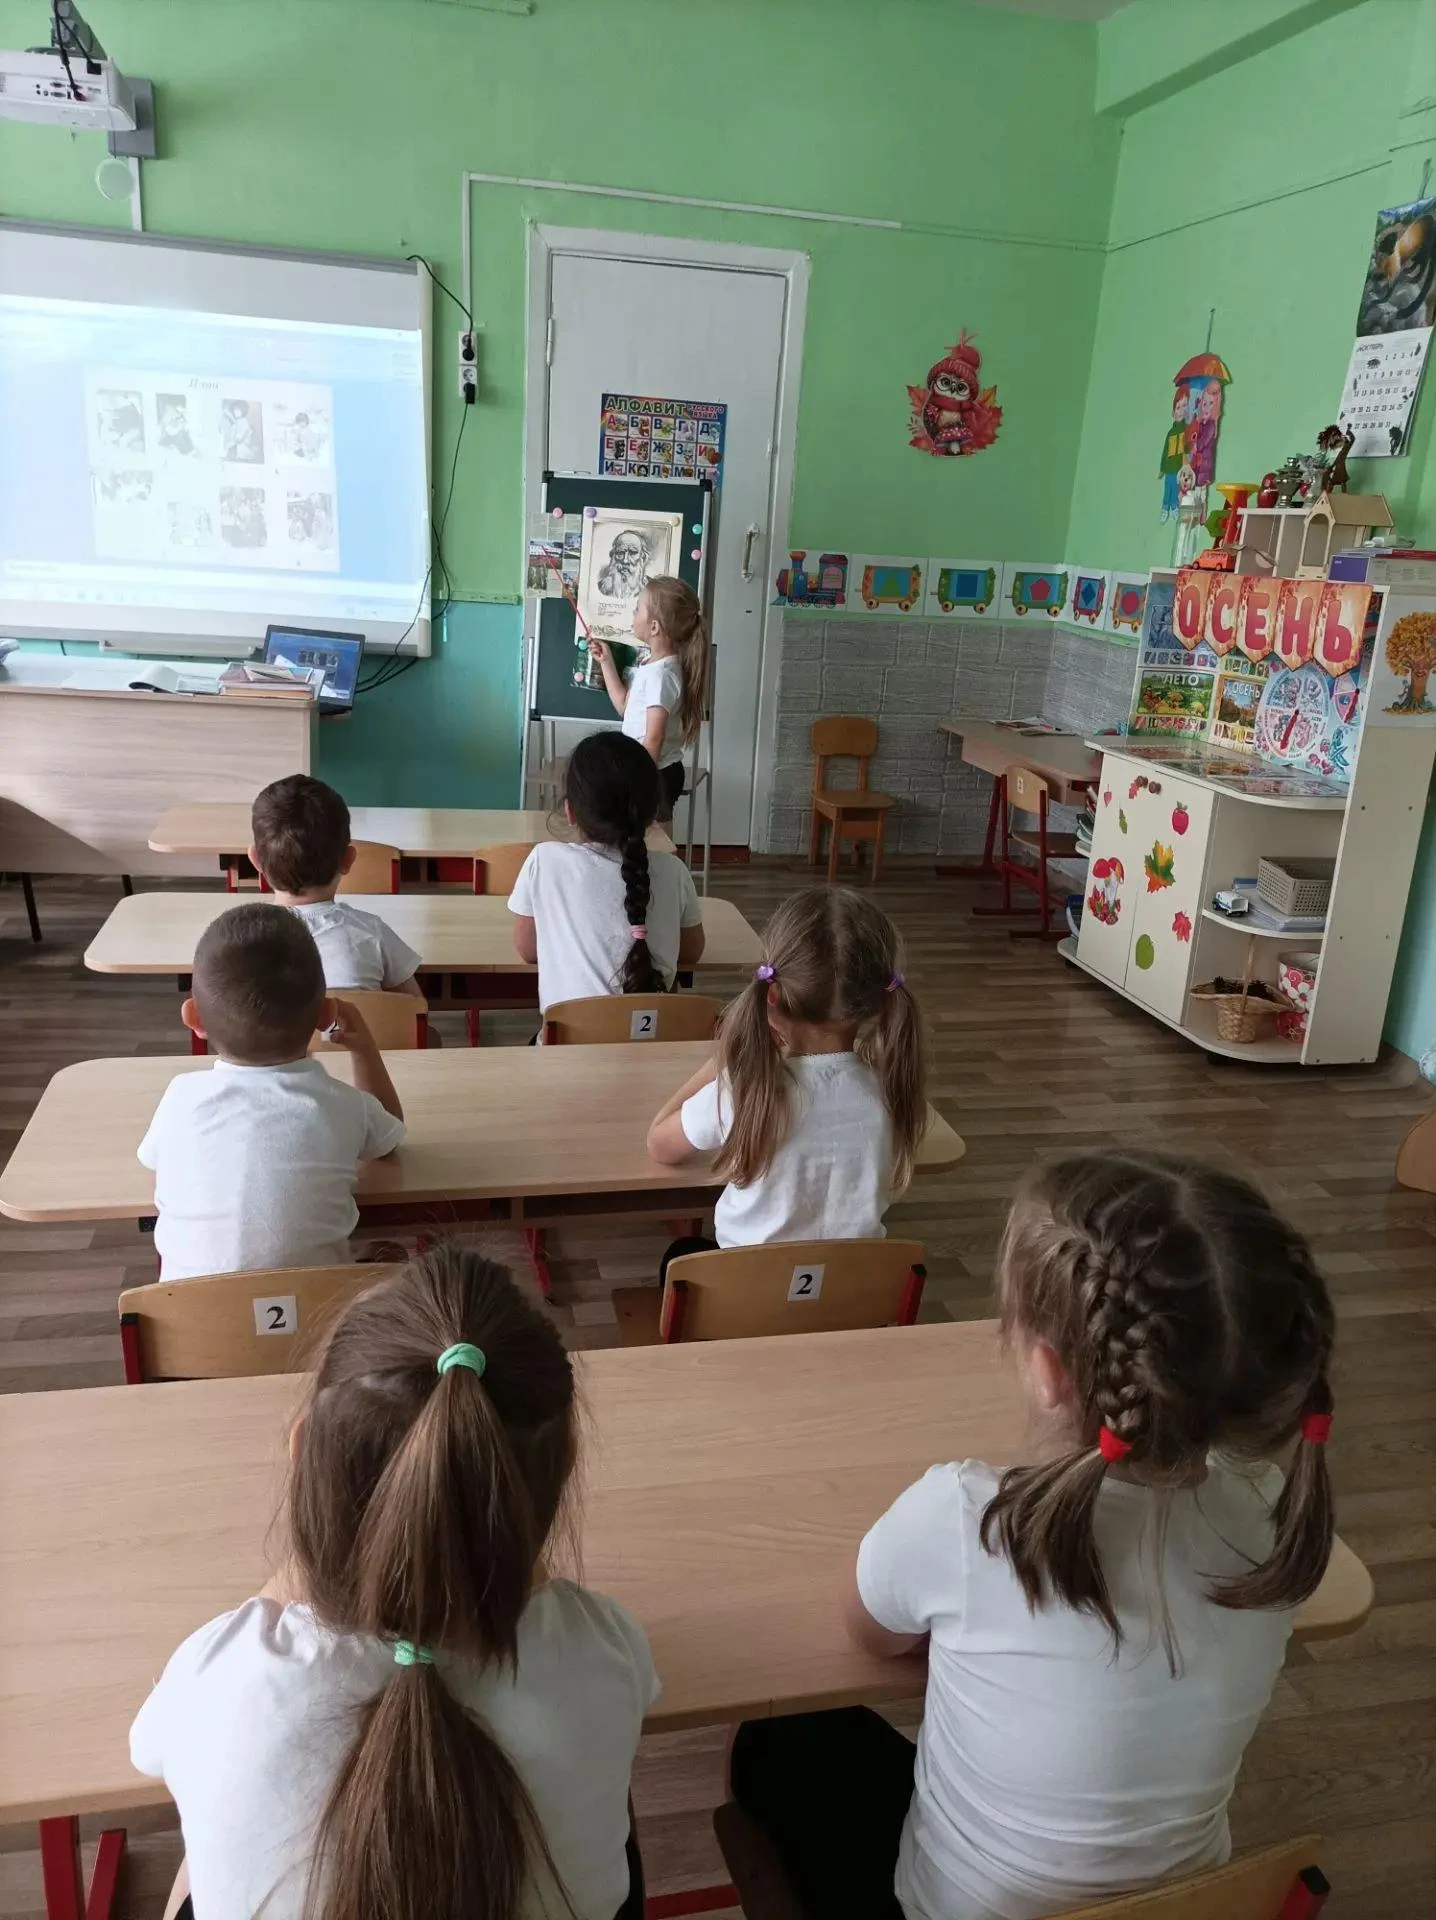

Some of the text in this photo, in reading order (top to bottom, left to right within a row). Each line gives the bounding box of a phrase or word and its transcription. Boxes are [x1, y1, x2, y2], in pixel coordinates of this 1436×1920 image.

[605, 397, 687, 415] АЛФАВИТ
[608, 414, 710, 436] А Б В Г Д
[606, 438, 614, 449] Е
[653, 441, 665, 453] Ж
[676, 444, 684, 454] З
[698, 445, 707, 456] И
[628, 463, 637, 474] К
[651, 465, 660, 476] Л
[674, 467, 684, 477] М
[697, 469, 706, 480] Н
[1178, 585, 1353, 663] ОСЕНЬ
[1164, 673, 1200, 686] ЛЕТО
[1232, 682, 1261, 698] ОСЕНЬ
[640, 1015, 652, 1032] 2
[796, 1273, 813, 1295] 2
[266, 1306, 287, 1330] 2
